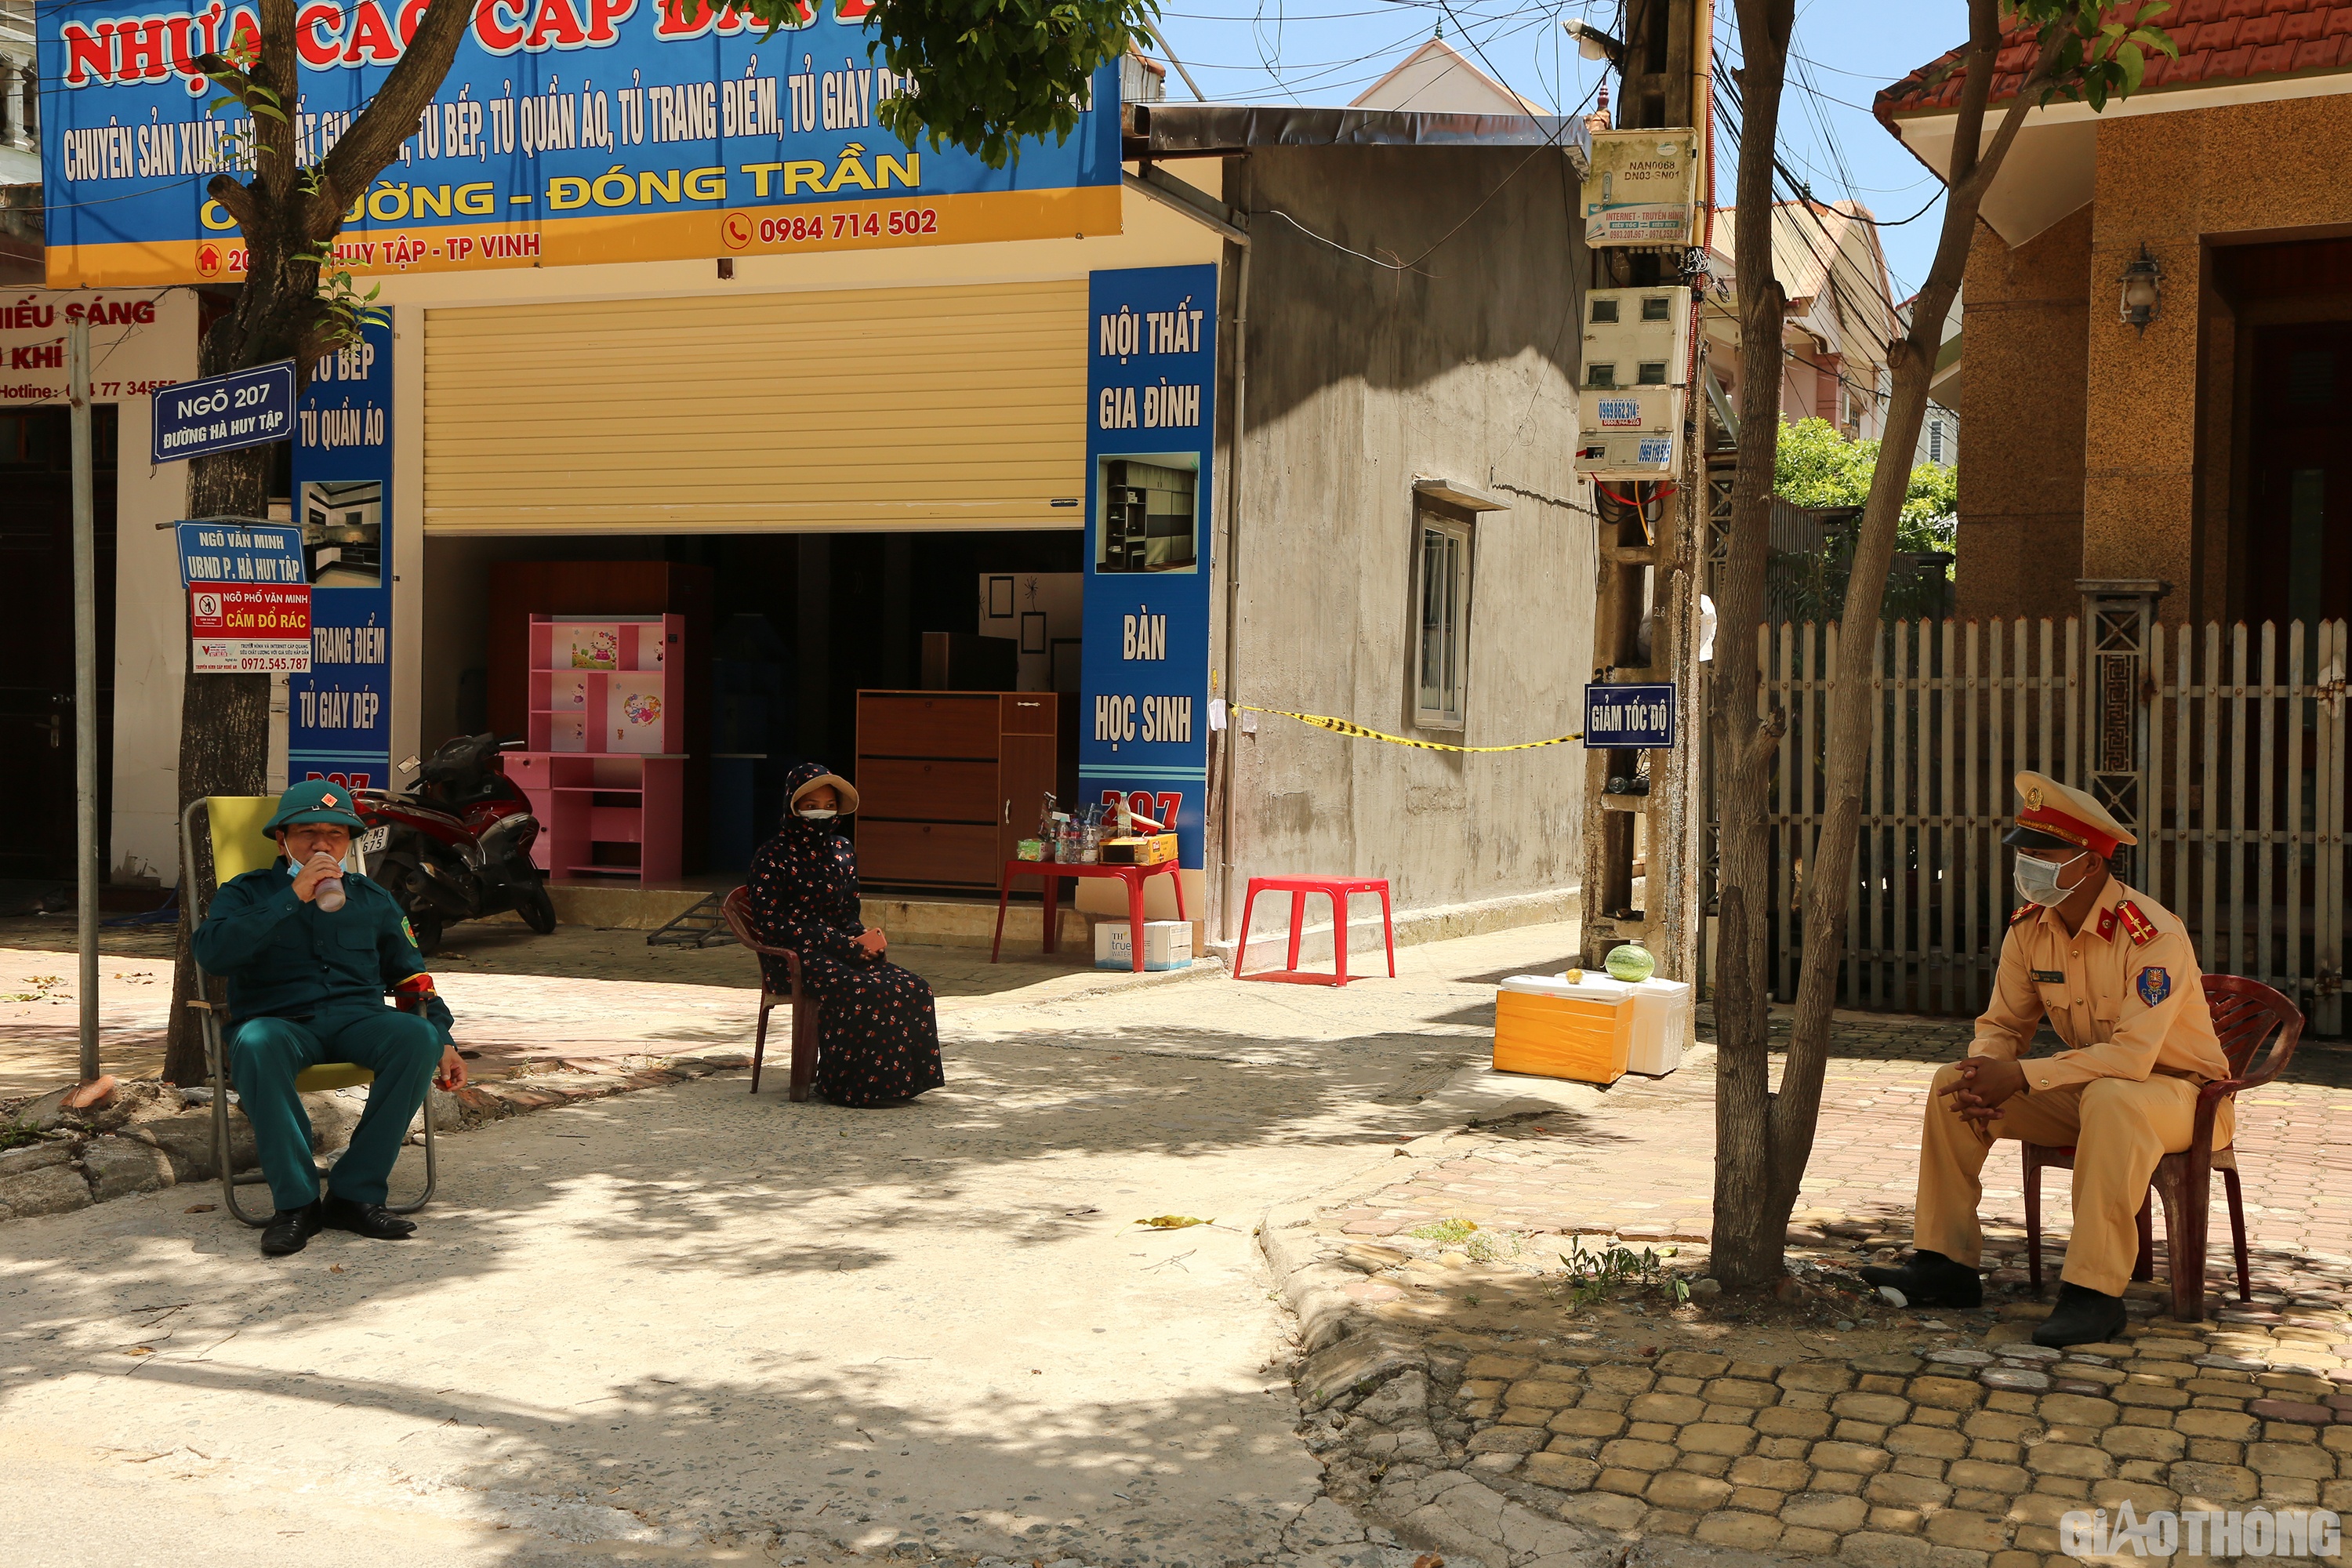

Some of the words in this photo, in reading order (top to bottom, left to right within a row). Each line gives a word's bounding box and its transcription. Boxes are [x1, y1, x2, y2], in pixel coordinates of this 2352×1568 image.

[64, 115, 134, 182] CHUYÊN
[137, 106, 176, 177] SẢN
[444, 82, 486, 163] BẾP,
[489, 78, 514, 154] TỦ
[521, 74, 576, 159] QUẦN
[581, 80, 614, 154] ÁO,
[618, 68, 644, 146] TỦ
[648, 81, 717, 143] TRANG
[721, 53, 783, 142] ĐIỂM,
[788, 53, 816, 133] TỦ
[821, 56, 873, 131] GIÀY
[546, 165, 727, 211] ĐÓNG
[741, 142, 921, 198] TRẦN
[1629, 161, 1675, 170] NAN0068
[759, 215, 824, 243] 0984
[831, 213, 880, 238] 714
[887, 209, 938, 236] 502
[1606, 212, 1636, 221] INTERNET
[382, 235, 426, 270] TẬP
[446, 238, 474, 261] TP
[480, 233, 541, 260] VINH
[0, 294, 54, 329] IẾU
[64, 296, 155, 325] SÁNG
[1100, 304, 1140, 365] NỘI
[1146, 295, 1203, 354] THẤT
[11, 338, 64, 370] KHÍ
[101, 382, 121, 397] 77
[177, 388, 230, 419] NGÕ
[234, 383, 270, 408] 207
[1099, 387, 1138, 430] GIA
[1143, 376, 1200, 428] ĐÌNH
[299, 397, 318, 448] TỦ
[321, 396, 361, 452] QUẦN
[364, 400, 384, 446] ÁO
[1599, 402, 1636, 419] 0969.862.314
[163, 424, 207, 449] ĐƯỜNG
[209, 419, 227, 441] HÀ
[230, 415, 257, 437] HUY
[258, 409, 284, 432] TẬP
[198, 529, 225, 547] NGÕ
[227, 530, 252, 548] VĂN
[253, 535, 285, 550] MINH
[187, 555, 222, 579] UBND
[237, 553, 254, 580] HÀ
[255, 557, 276, 580] HUY
[223, 591, 242, 603] NGÕ
[244, 589, 263, 603] PHỐ
[264, 591, 284, 604] VĂN
[285, 594, 308, 604] MINH
[1653, 606, 1666, 617] 28
[226, 608, 255, 628] CẤM
[257, 606, 278, 629] ĐỔ
[280, 611, 307, 628] RÁC
[1122, 604, 1166, 660] BÀN
[314, 627, 351, 664] TRANG
[354, 612, 385, 664] ĐIỂM
[241, 658, 308, 670] 0972.545.787
[299, 679, 315, 728] TỦ
[319, 684, 350, 728] GIÀY
[353, 684, 379, 729] DÉP
[1592, 694, 1622, 731] GIẢM
[1624, 695, 1647, 731] TỐC
[1650, 699, 1667, 737] ĐỘ
[1094, 695, 1136, 752] HỌC
[1142, 695, 1192, 742] SINH
[1100, 790, 1183, 831] 207
[1112, 940, 1131, 951] true
